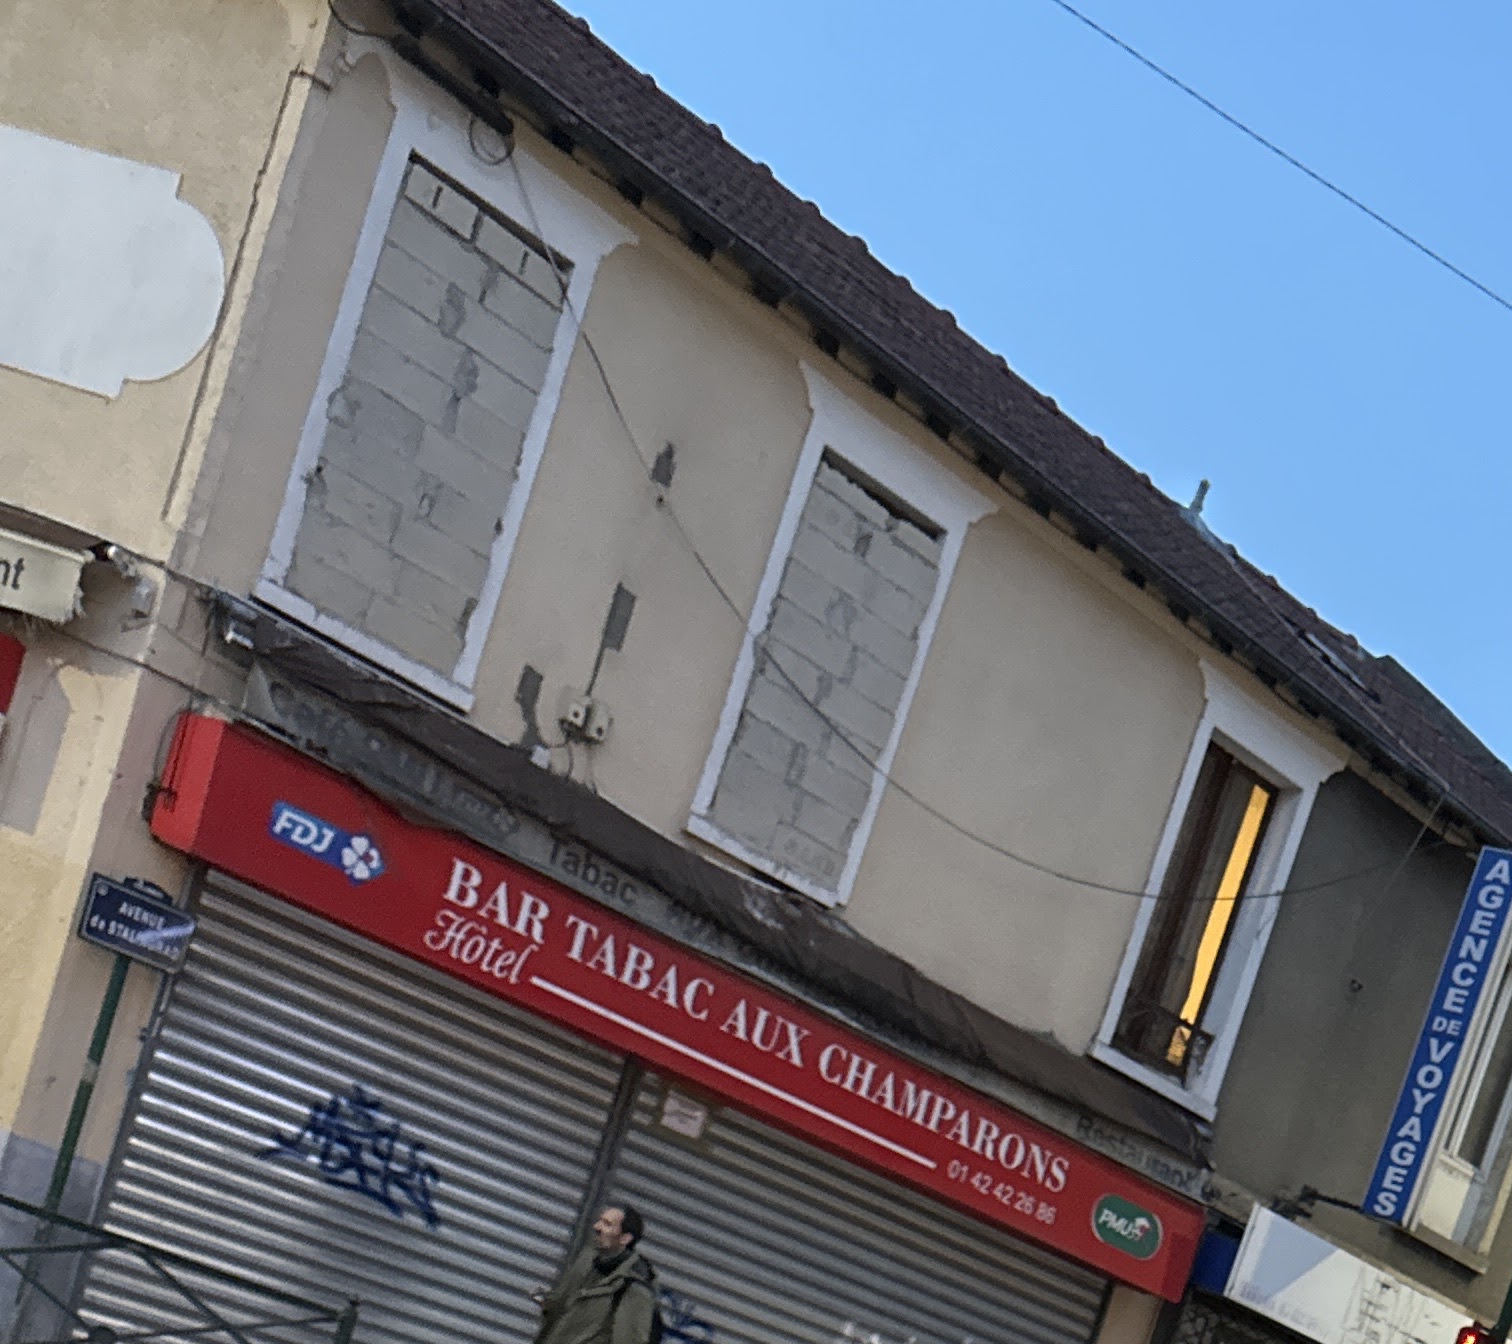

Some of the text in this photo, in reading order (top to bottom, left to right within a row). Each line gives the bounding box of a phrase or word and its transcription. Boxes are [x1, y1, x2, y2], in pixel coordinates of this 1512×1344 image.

[272, 809, 337, 854] FDJ
[423, 909, 540, 985] Hôtel
[443, 857, 551, 945] BAR
[564, 914, 715, 1021] TABAC
[719, 998, 811, 1068] AUX
[818, 1043, 1070, 1193] CHAMPARONS
[1373, 858, 1512, 1218] AGENCE DE VOYAGES
[947, 1159, 968, 1184] 01
[971, 1172, 993, 1195] 42
[992, 1182, 1015, 1206] 42
[1098, 1209, 1136, 1238] PMU
